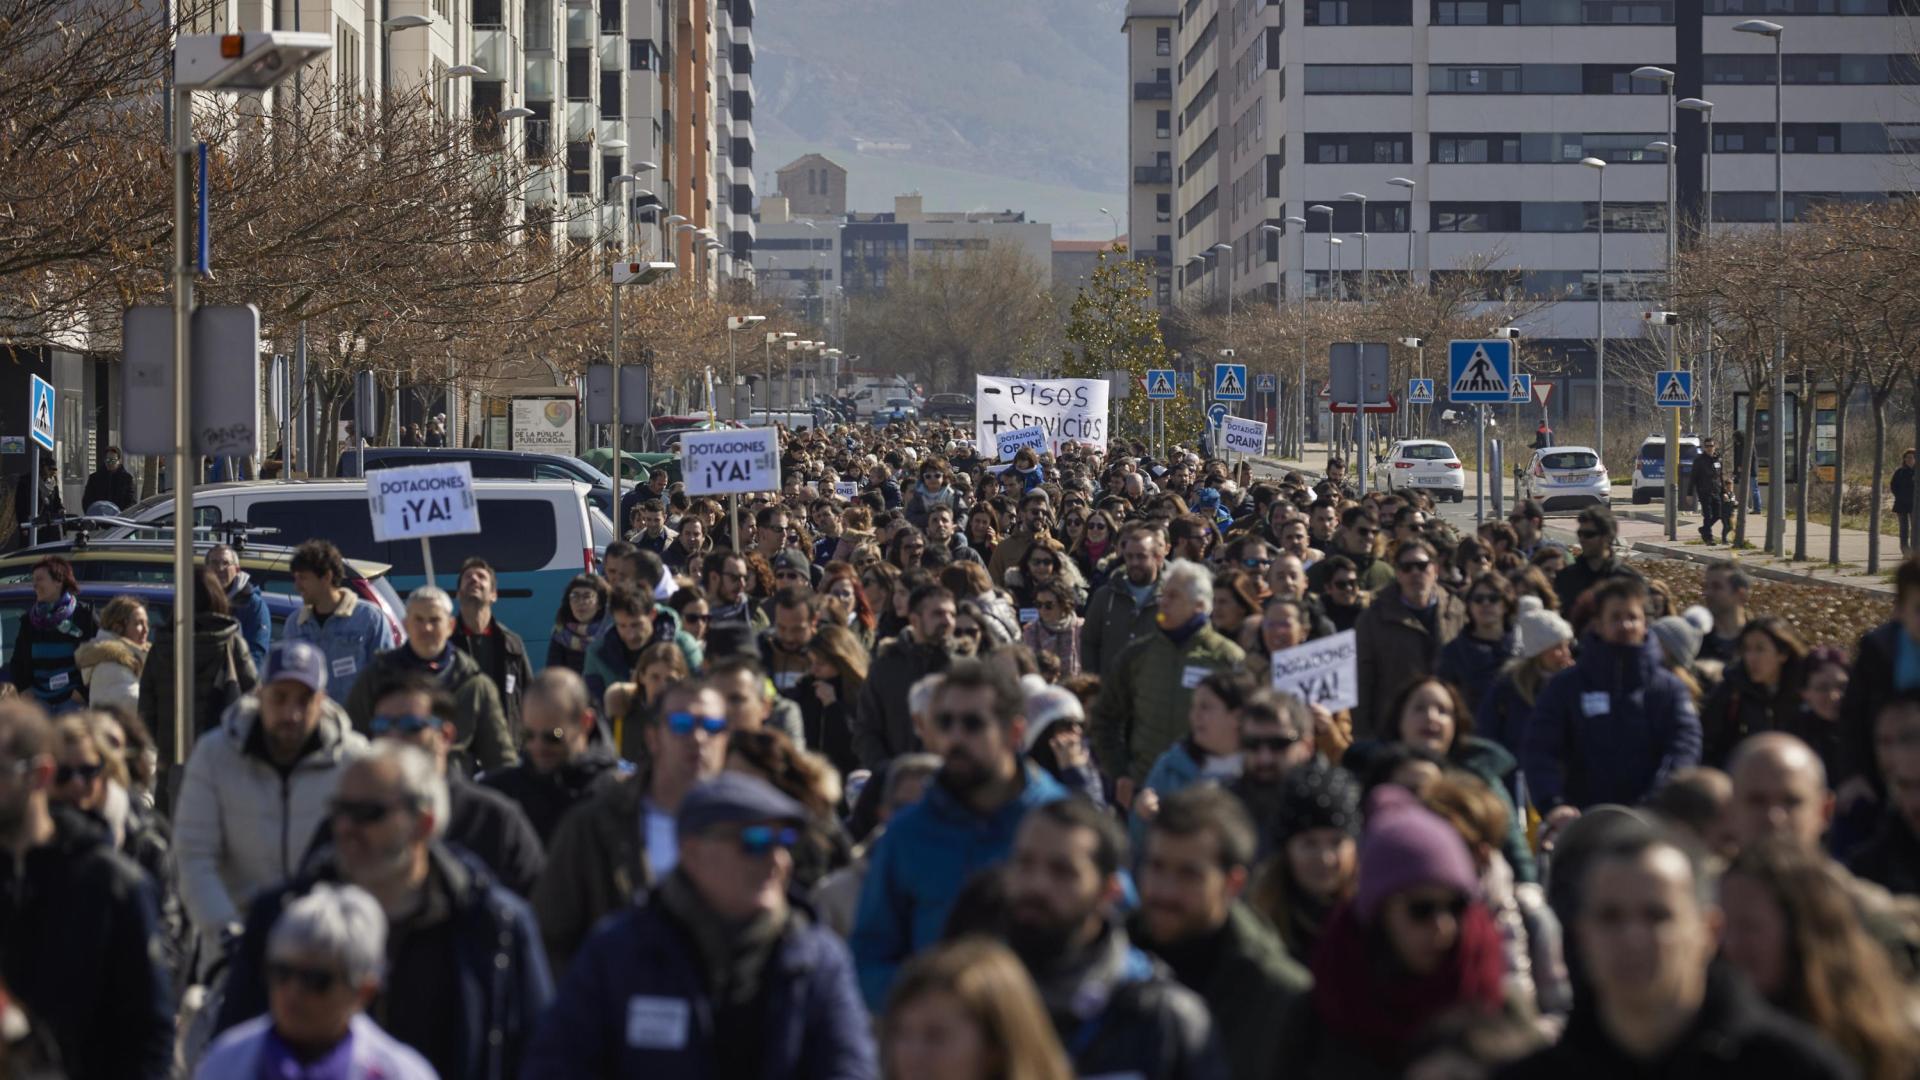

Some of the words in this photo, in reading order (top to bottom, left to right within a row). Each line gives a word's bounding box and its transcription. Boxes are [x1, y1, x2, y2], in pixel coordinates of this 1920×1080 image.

[689, 440, 766, 456] DOTACIONES
[380, 475, 465, 495] DOTACIONES
[705, 459, 751, 489] ¡YA!
[401, 496, 452, 531] ¡YA!
